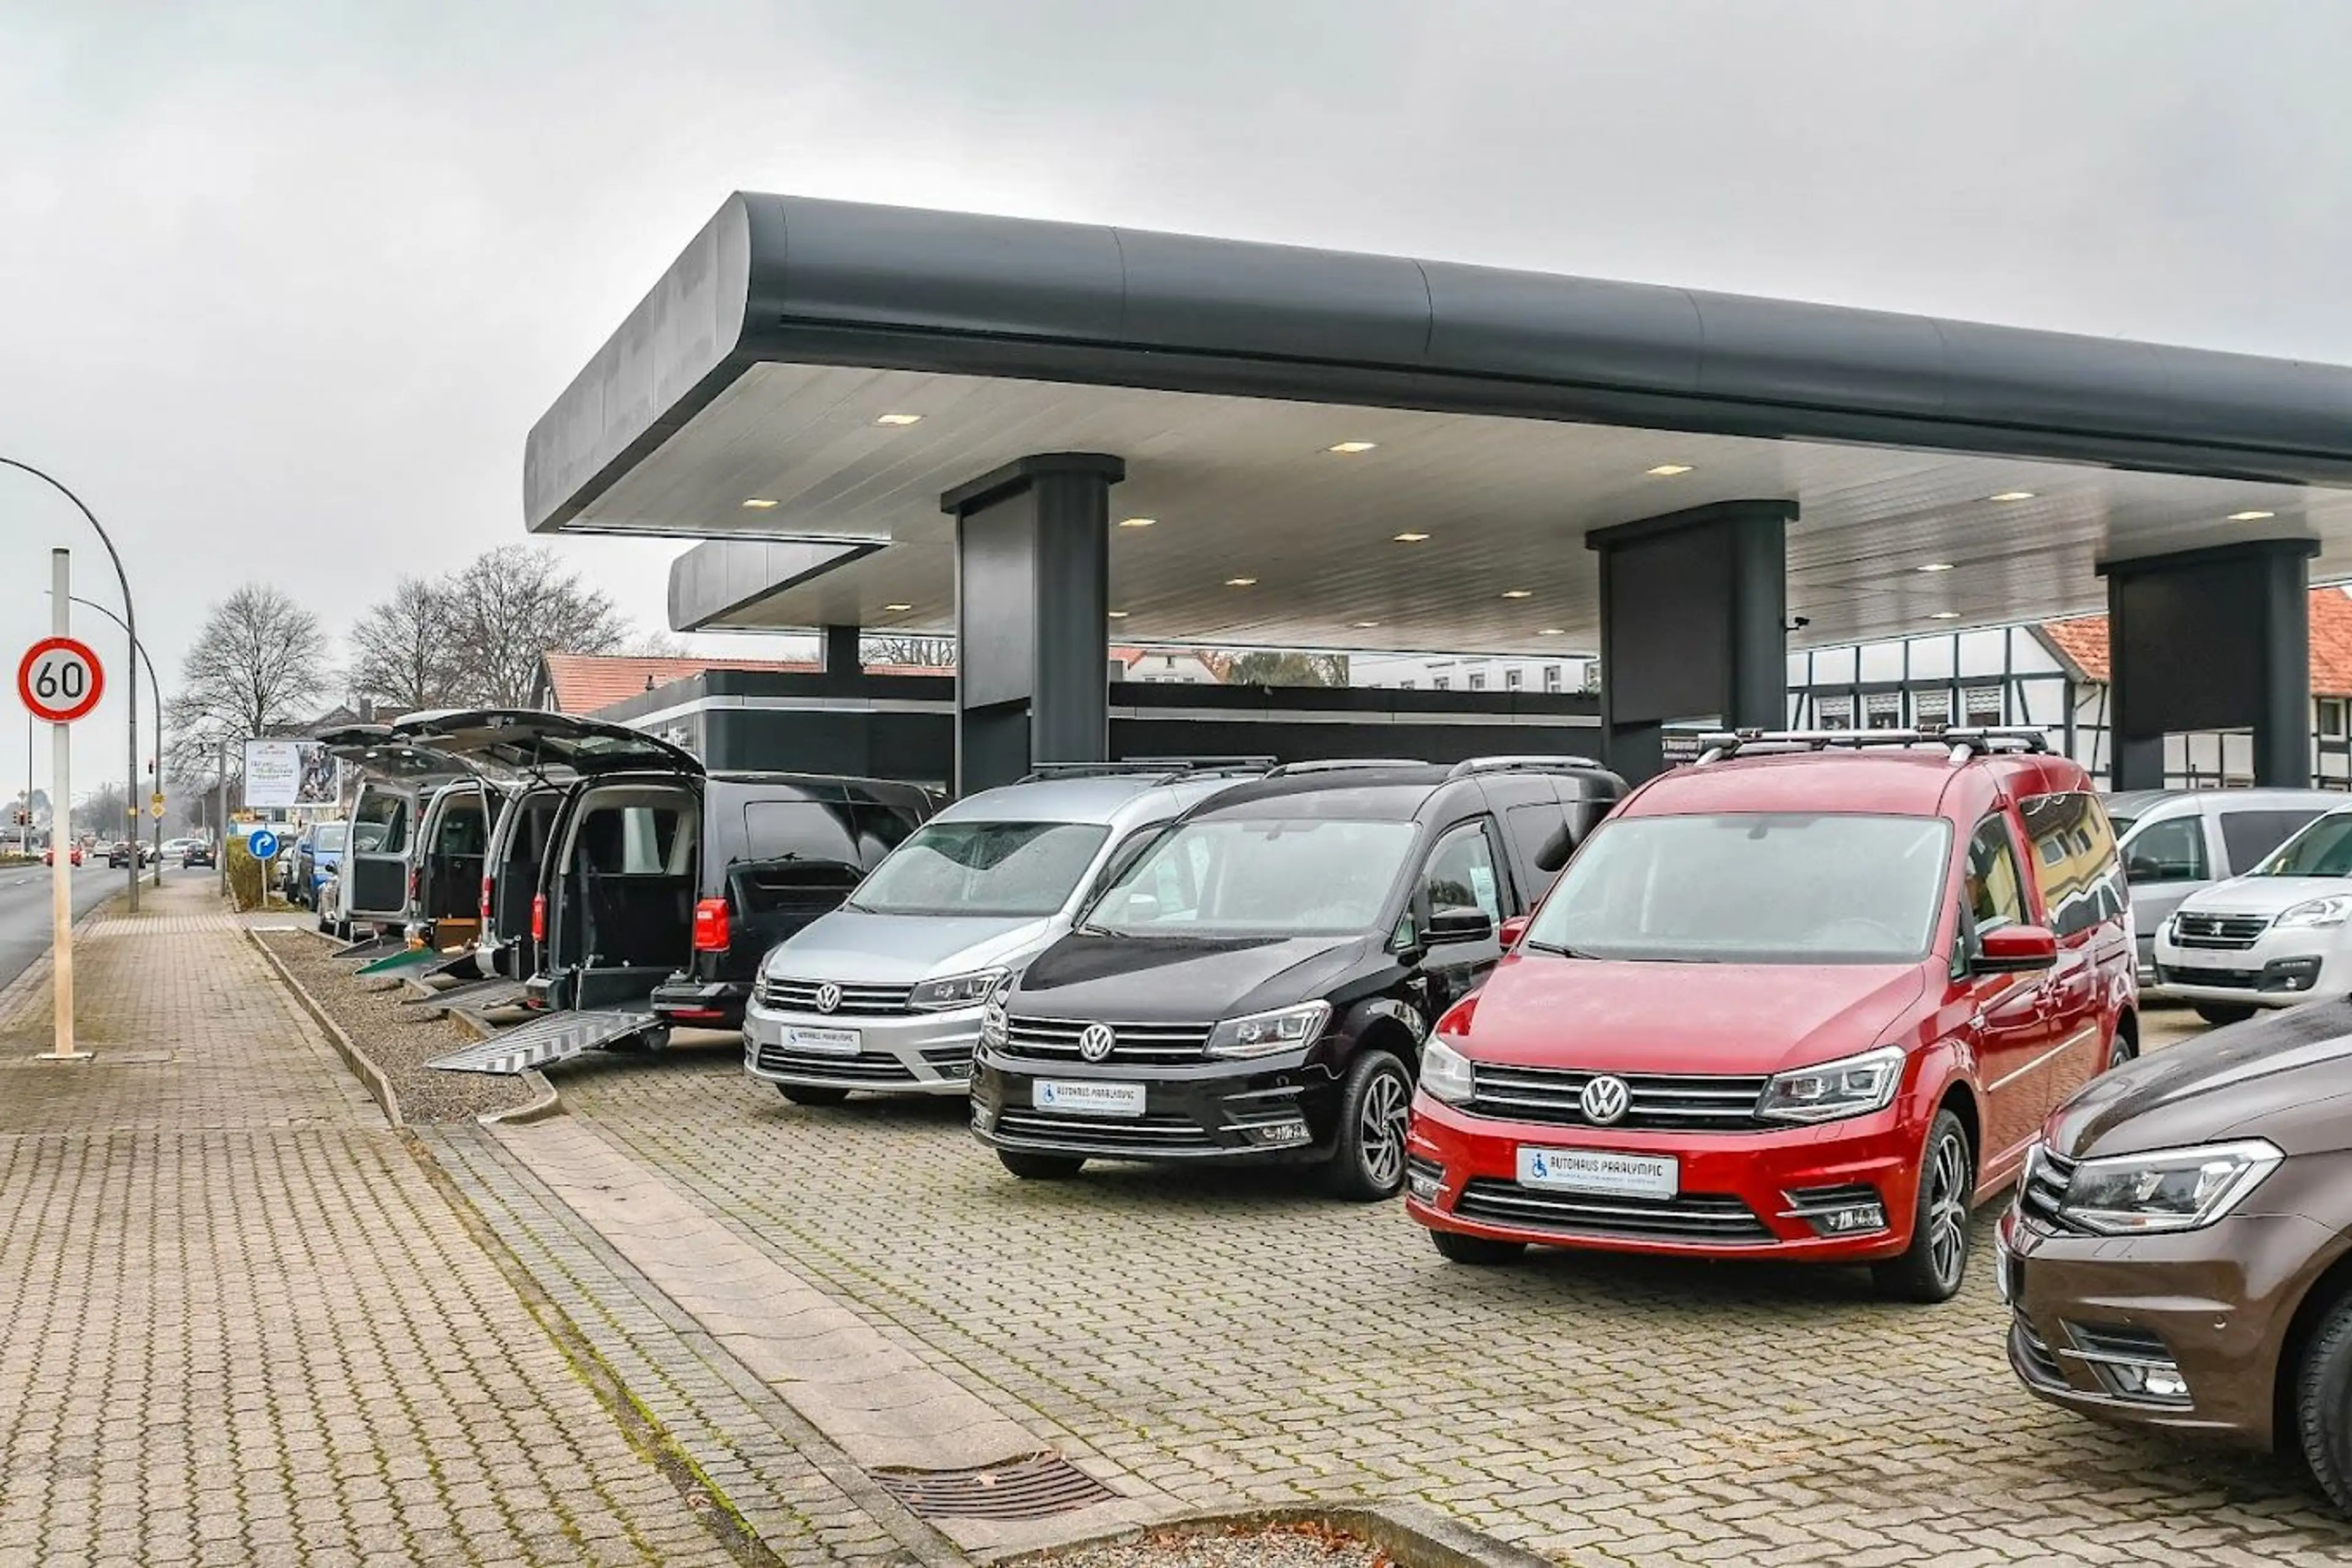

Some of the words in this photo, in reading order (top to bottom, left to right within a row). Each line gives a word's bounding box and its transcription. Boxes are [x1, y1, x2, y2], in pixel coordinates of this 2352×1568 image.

[37, 662, 83, 698] 60
[816, 984, 839, 1013] VW
[1080, 1024, 1111, 1061] VW
[1580, 1076, 1627, 1123] VW
[1550, 1156, 1599, 1172] AUTOHAUS
[1600, 1160, 1663, 1177] PARALYMPIC
